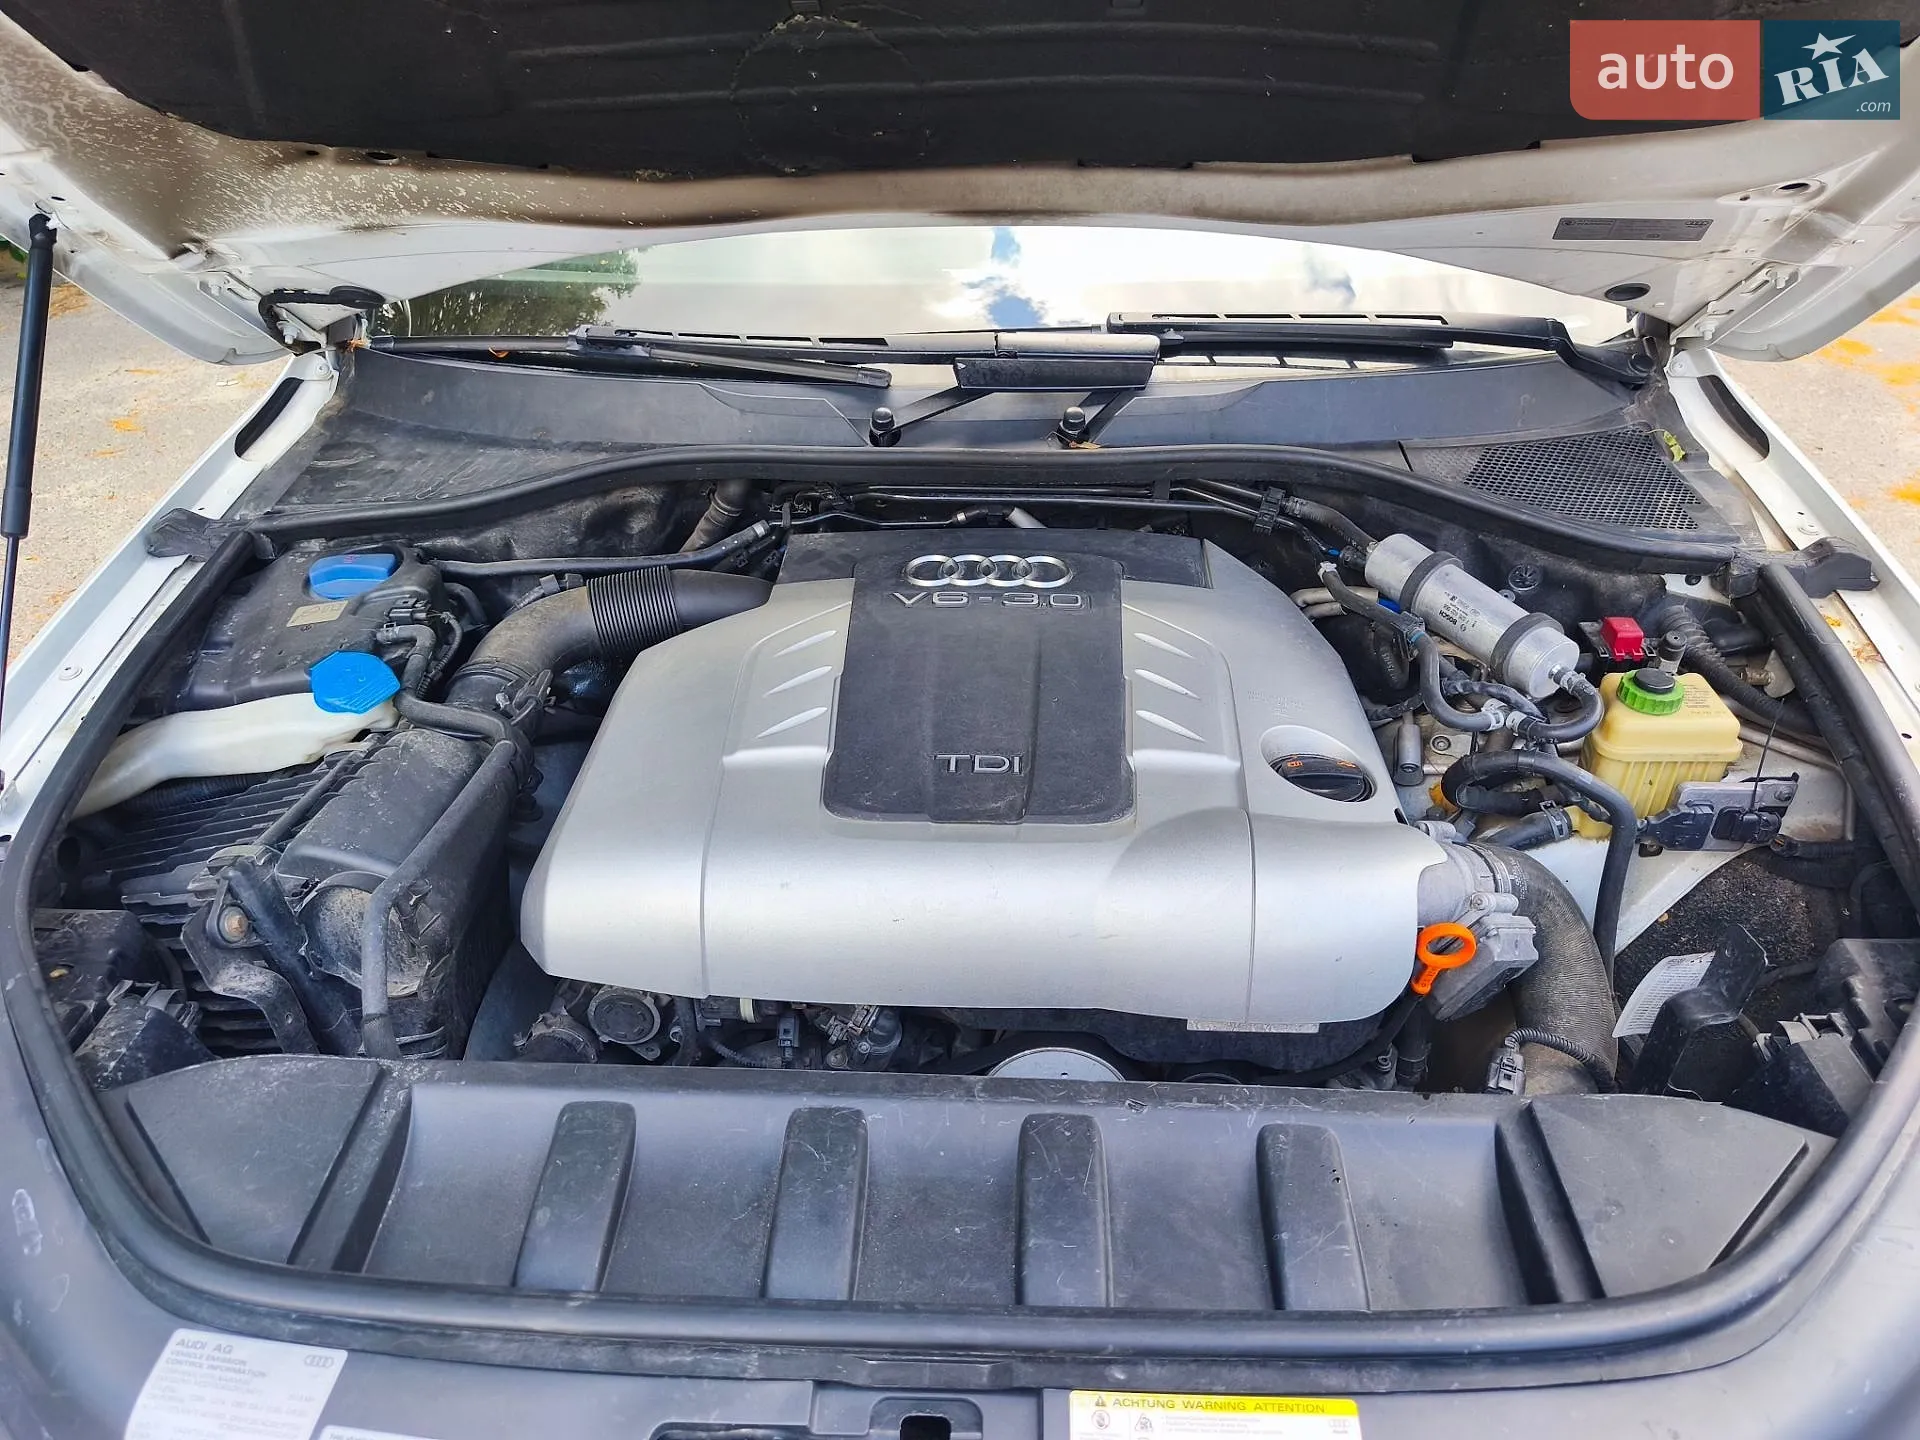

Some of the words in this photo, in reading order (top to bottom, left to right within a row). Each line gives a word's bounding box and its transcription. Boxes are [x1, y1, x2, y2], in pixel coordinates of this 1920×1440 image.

[1438, 609, 1458, 626] BOSCH
[935, 753, 1022, 775] TDI
[175, 1338, 208, 1351] AUDI
[213, 1342, 234, 1355] AG
[1112, 1397, 1176, 1410] ACHTUNG
[1182, 1400, 1247, 1411] WARNING
[1253, 1402, 1325, 1414] ATTENTION
